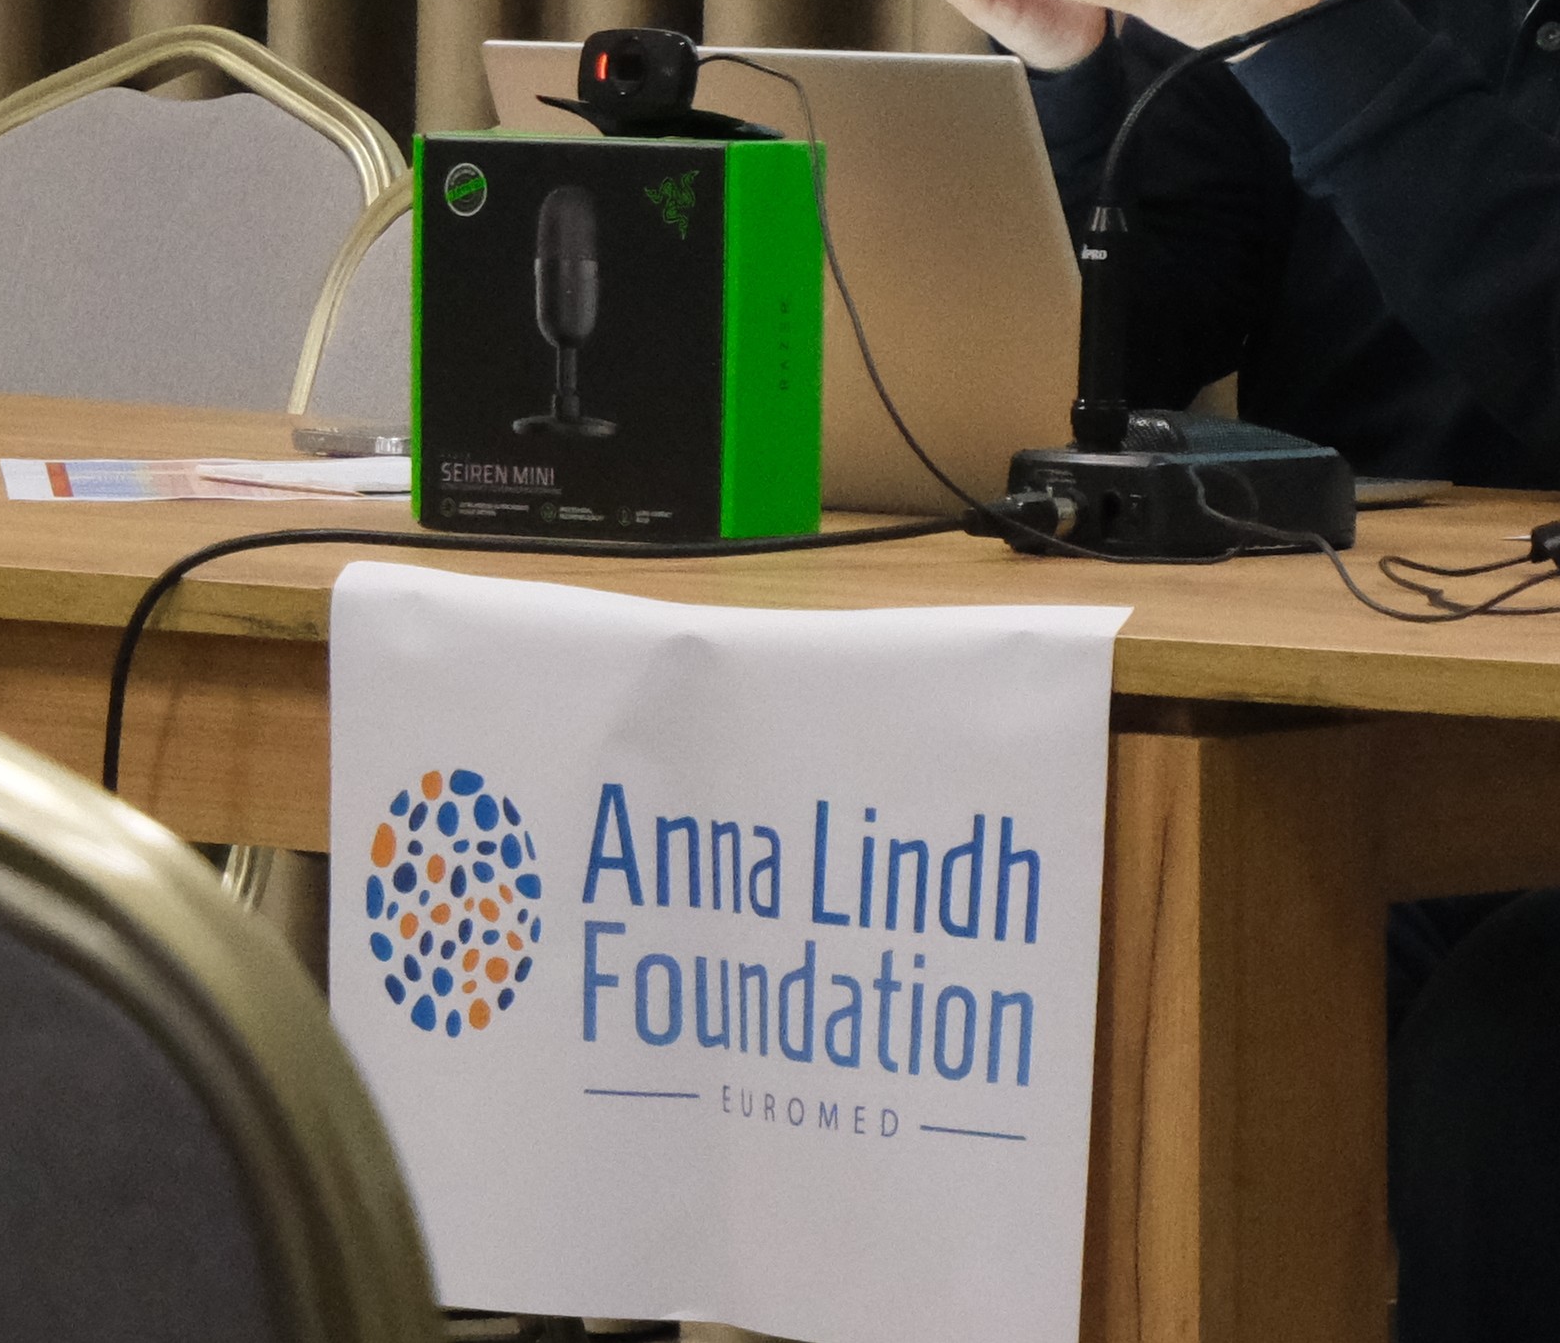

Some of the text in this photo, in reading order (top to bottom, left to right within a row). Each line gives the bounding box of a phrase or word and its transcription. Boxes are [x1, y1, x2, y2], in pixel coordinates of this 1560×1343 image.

[440, 462, 555, 486] SEIREN MINI
[581, 783, 1041, 945] Anna Lindh
[582, 921, 1033, 1086] Foundation
[722, 1085, 899, 1137] EUROMED
